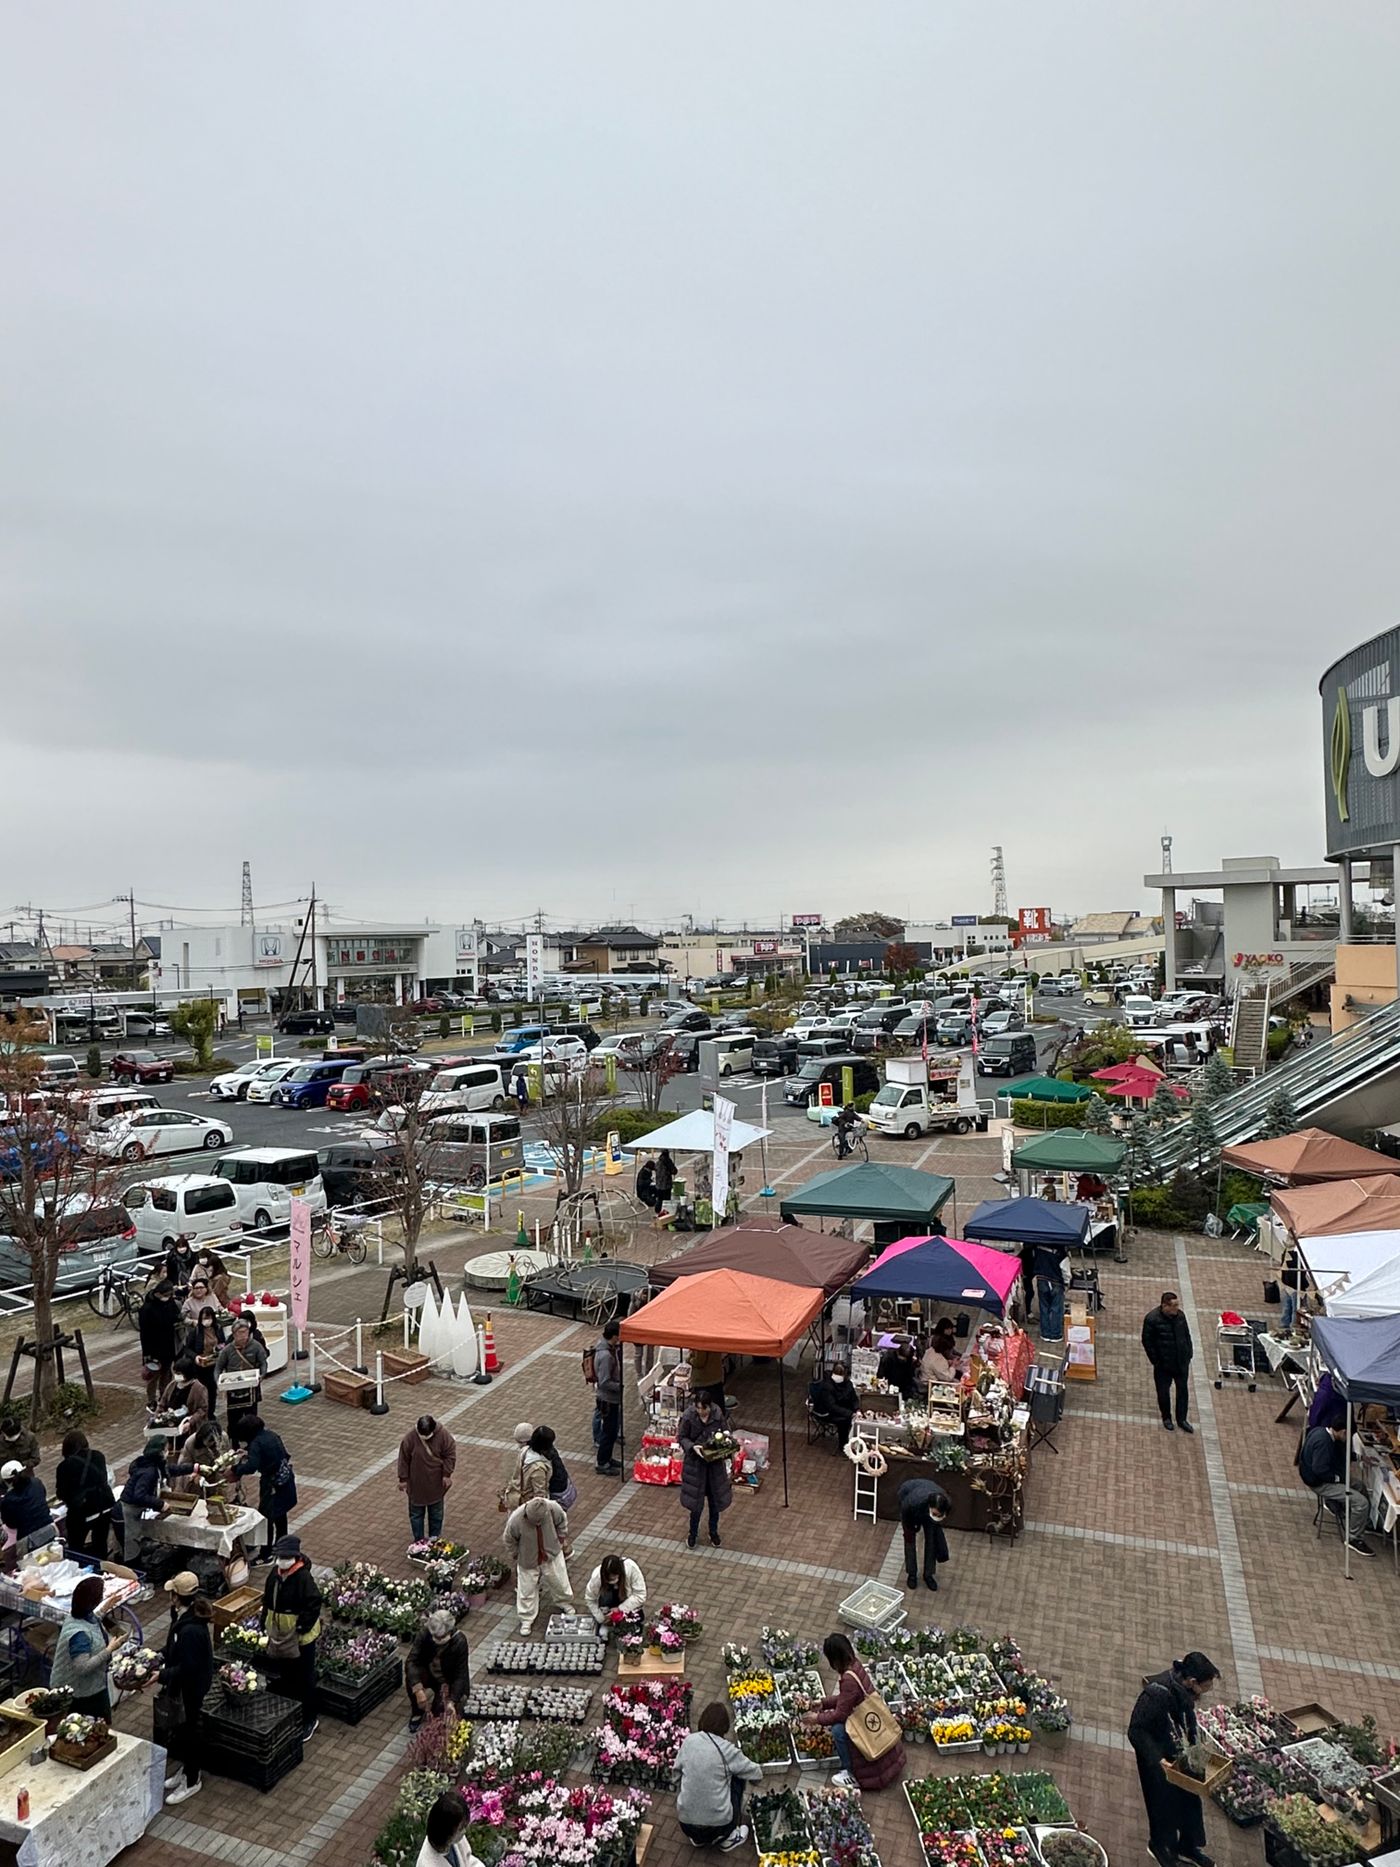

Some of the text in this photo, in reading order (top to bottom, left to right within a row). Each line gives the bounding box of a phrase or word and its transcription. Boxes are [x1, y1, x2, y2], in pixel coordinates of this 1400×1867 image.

[1363, 696, 1400, 776] U
[1023, 909, 1040, 928] 靴
[1244, 953, 1284, 963] YAOKO
[78, 997, 114, 1005] HONDA
[293, 1239, 303, 1302] マルシェ
